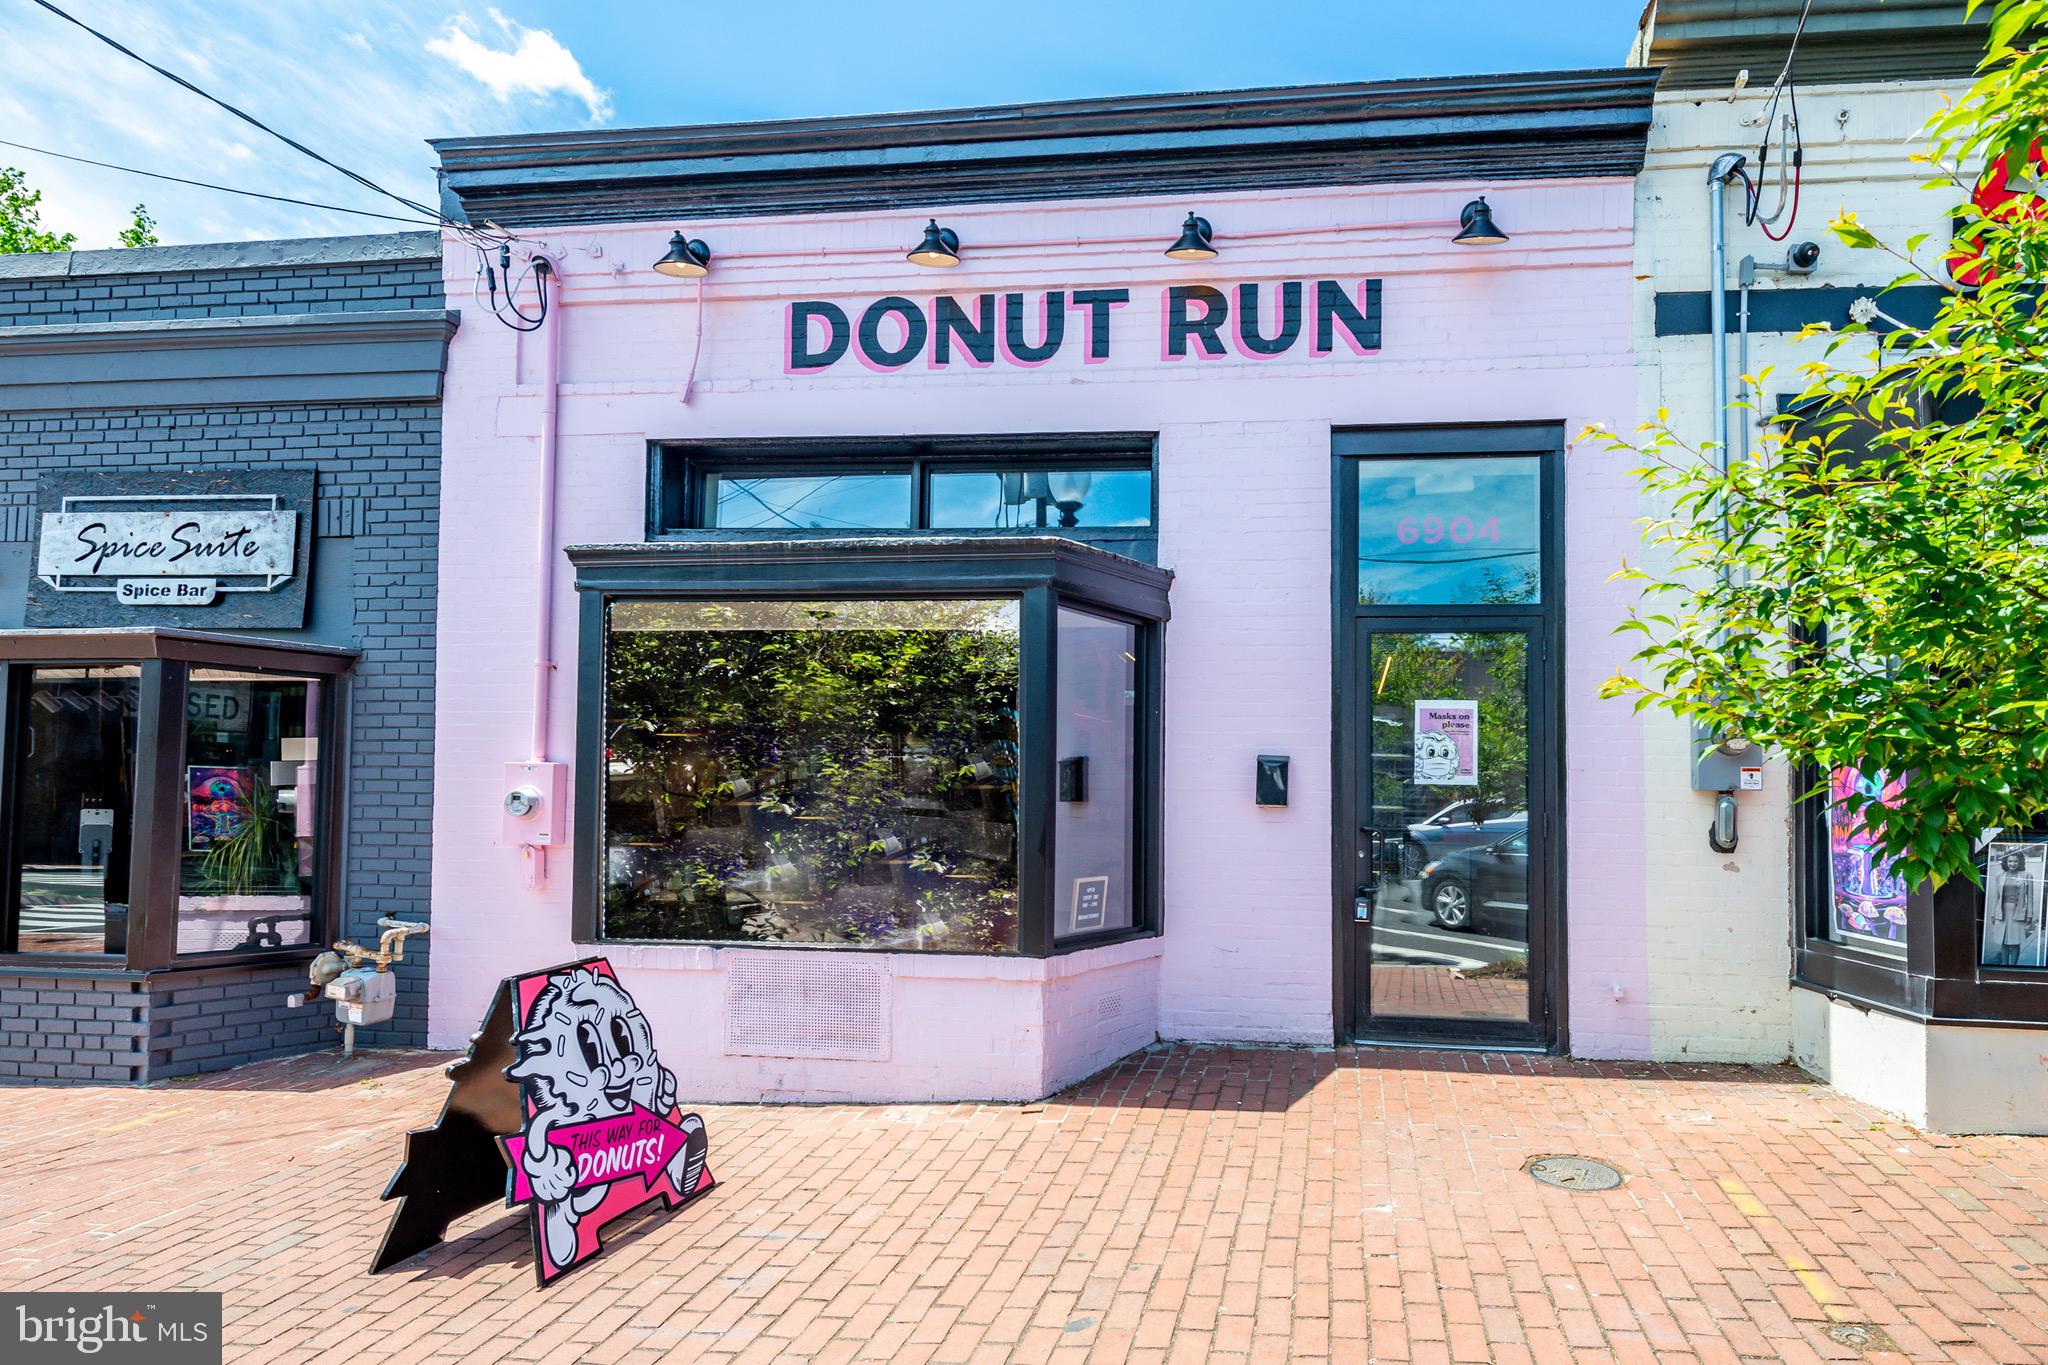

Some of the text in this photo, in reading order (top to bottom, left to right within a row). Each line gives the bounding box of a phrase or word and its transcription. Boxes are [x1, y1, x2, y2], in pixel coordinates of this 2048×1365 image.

[784, 278, 1383, 374] DONUT RUN
[1397, 515, 1501, 544] 6904
[74, 522, 260, 574] Spice Suite
[122, 584, 207, 600] Spice Bar
[187, 692, 240, 719] SED
[1429, 712, 1457, 720] Masks
[1442, 721, 1470, 729] please
[571, 1118, 664, 1151] THIS WAY FOR
[578, 1133, 665, 1183] DONUTS!
